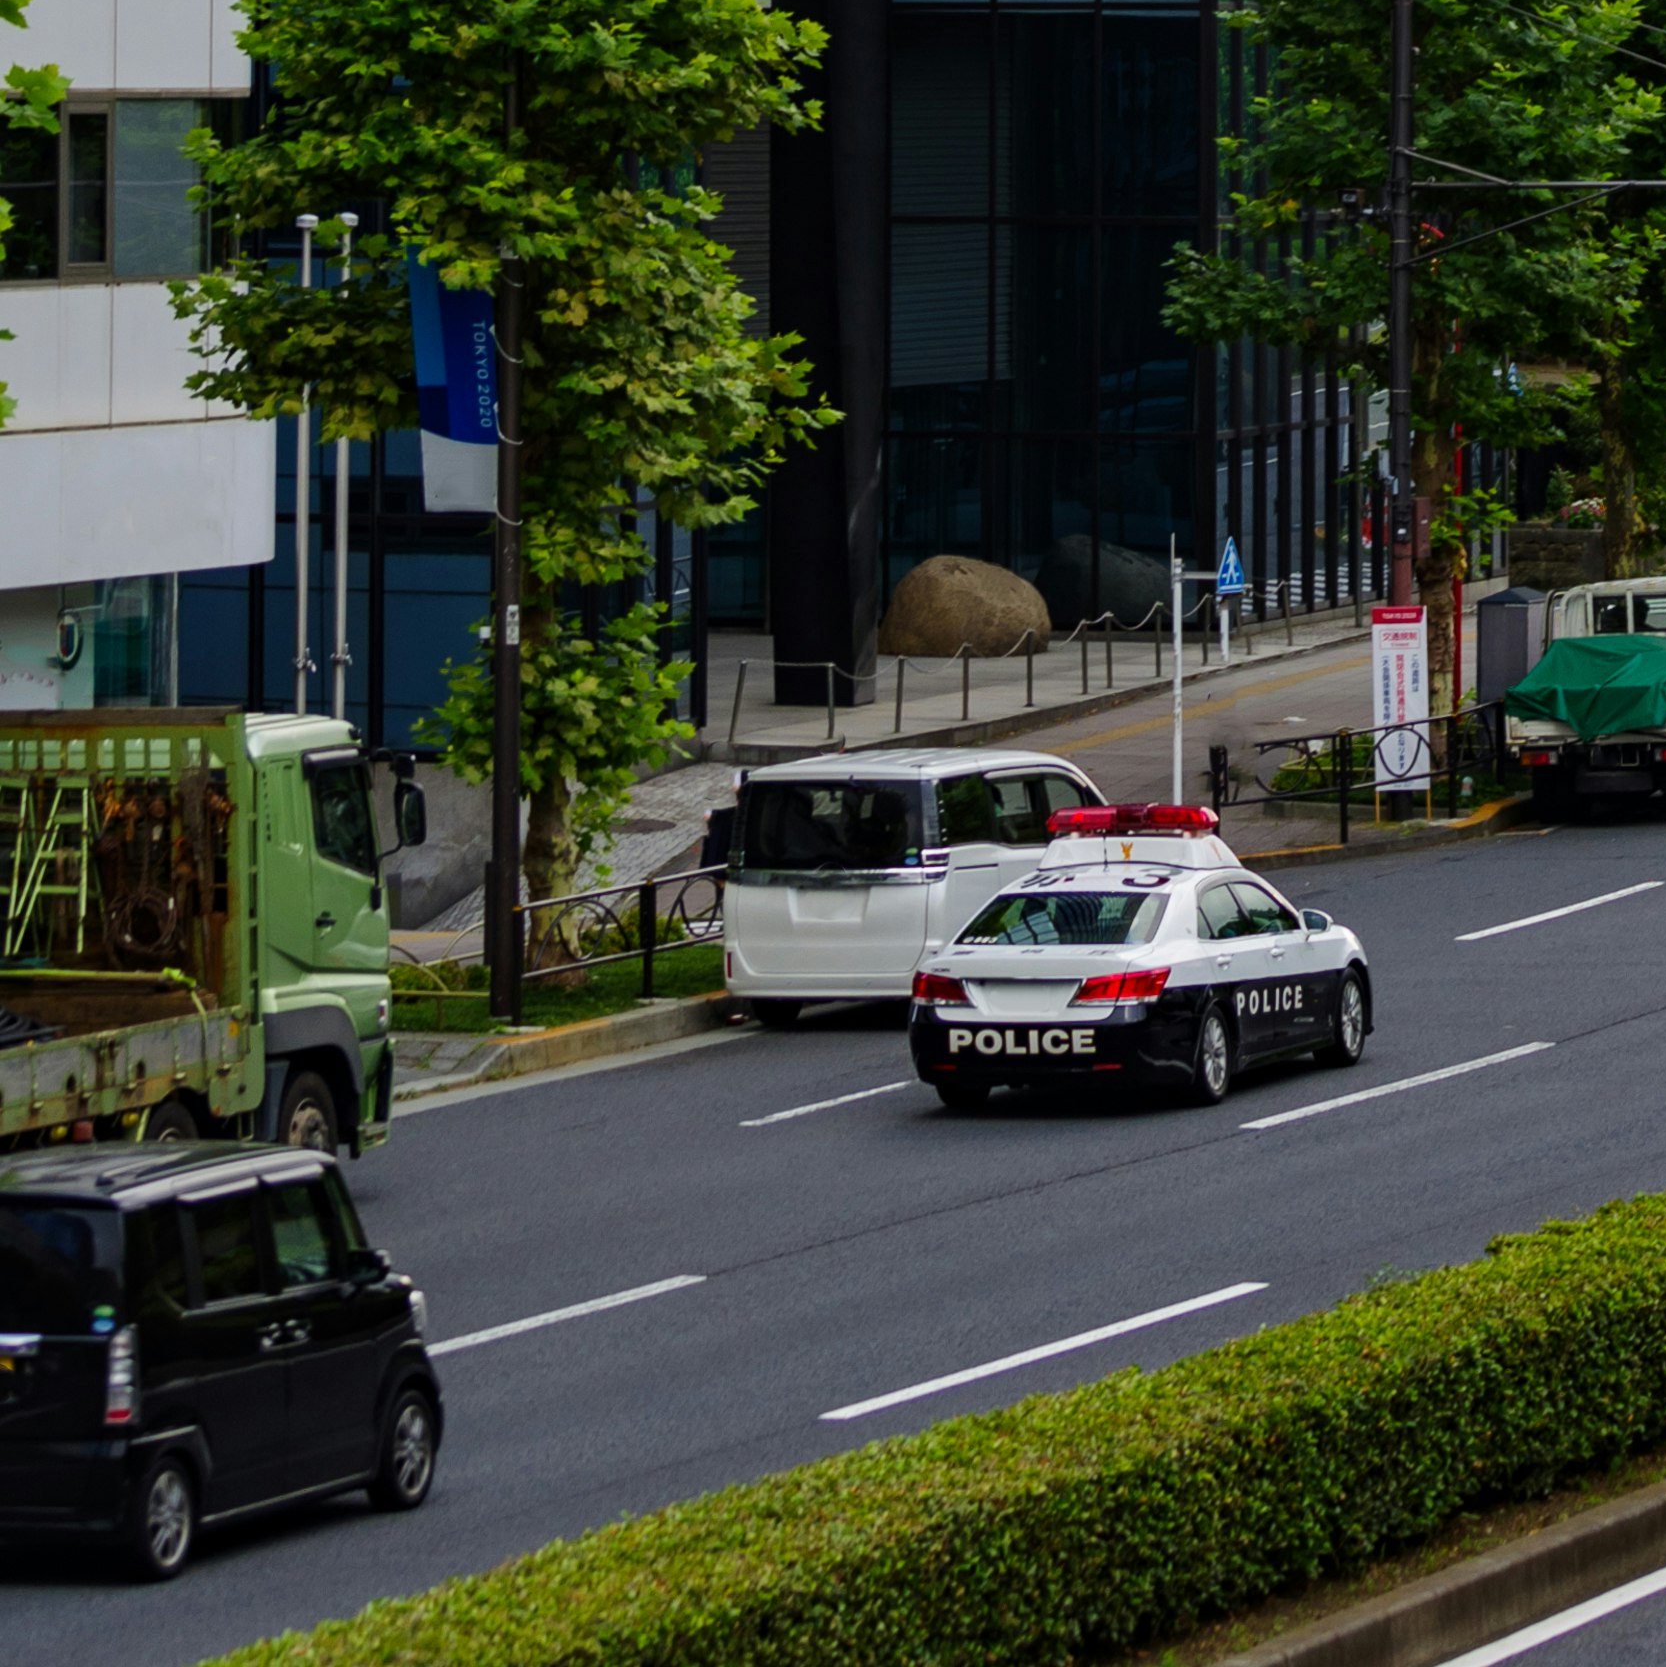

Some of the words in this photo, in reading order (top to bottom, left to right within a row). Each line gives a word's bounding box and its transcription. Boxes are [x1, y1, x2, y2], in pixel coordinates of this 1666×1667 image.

[472, 320, 489, 380] TOKYO
[478, 384, 493, 428] 2020
[1236, 985, 1303, 1017] POLICE
[948, 1029, 1097, 1055] POLICE
